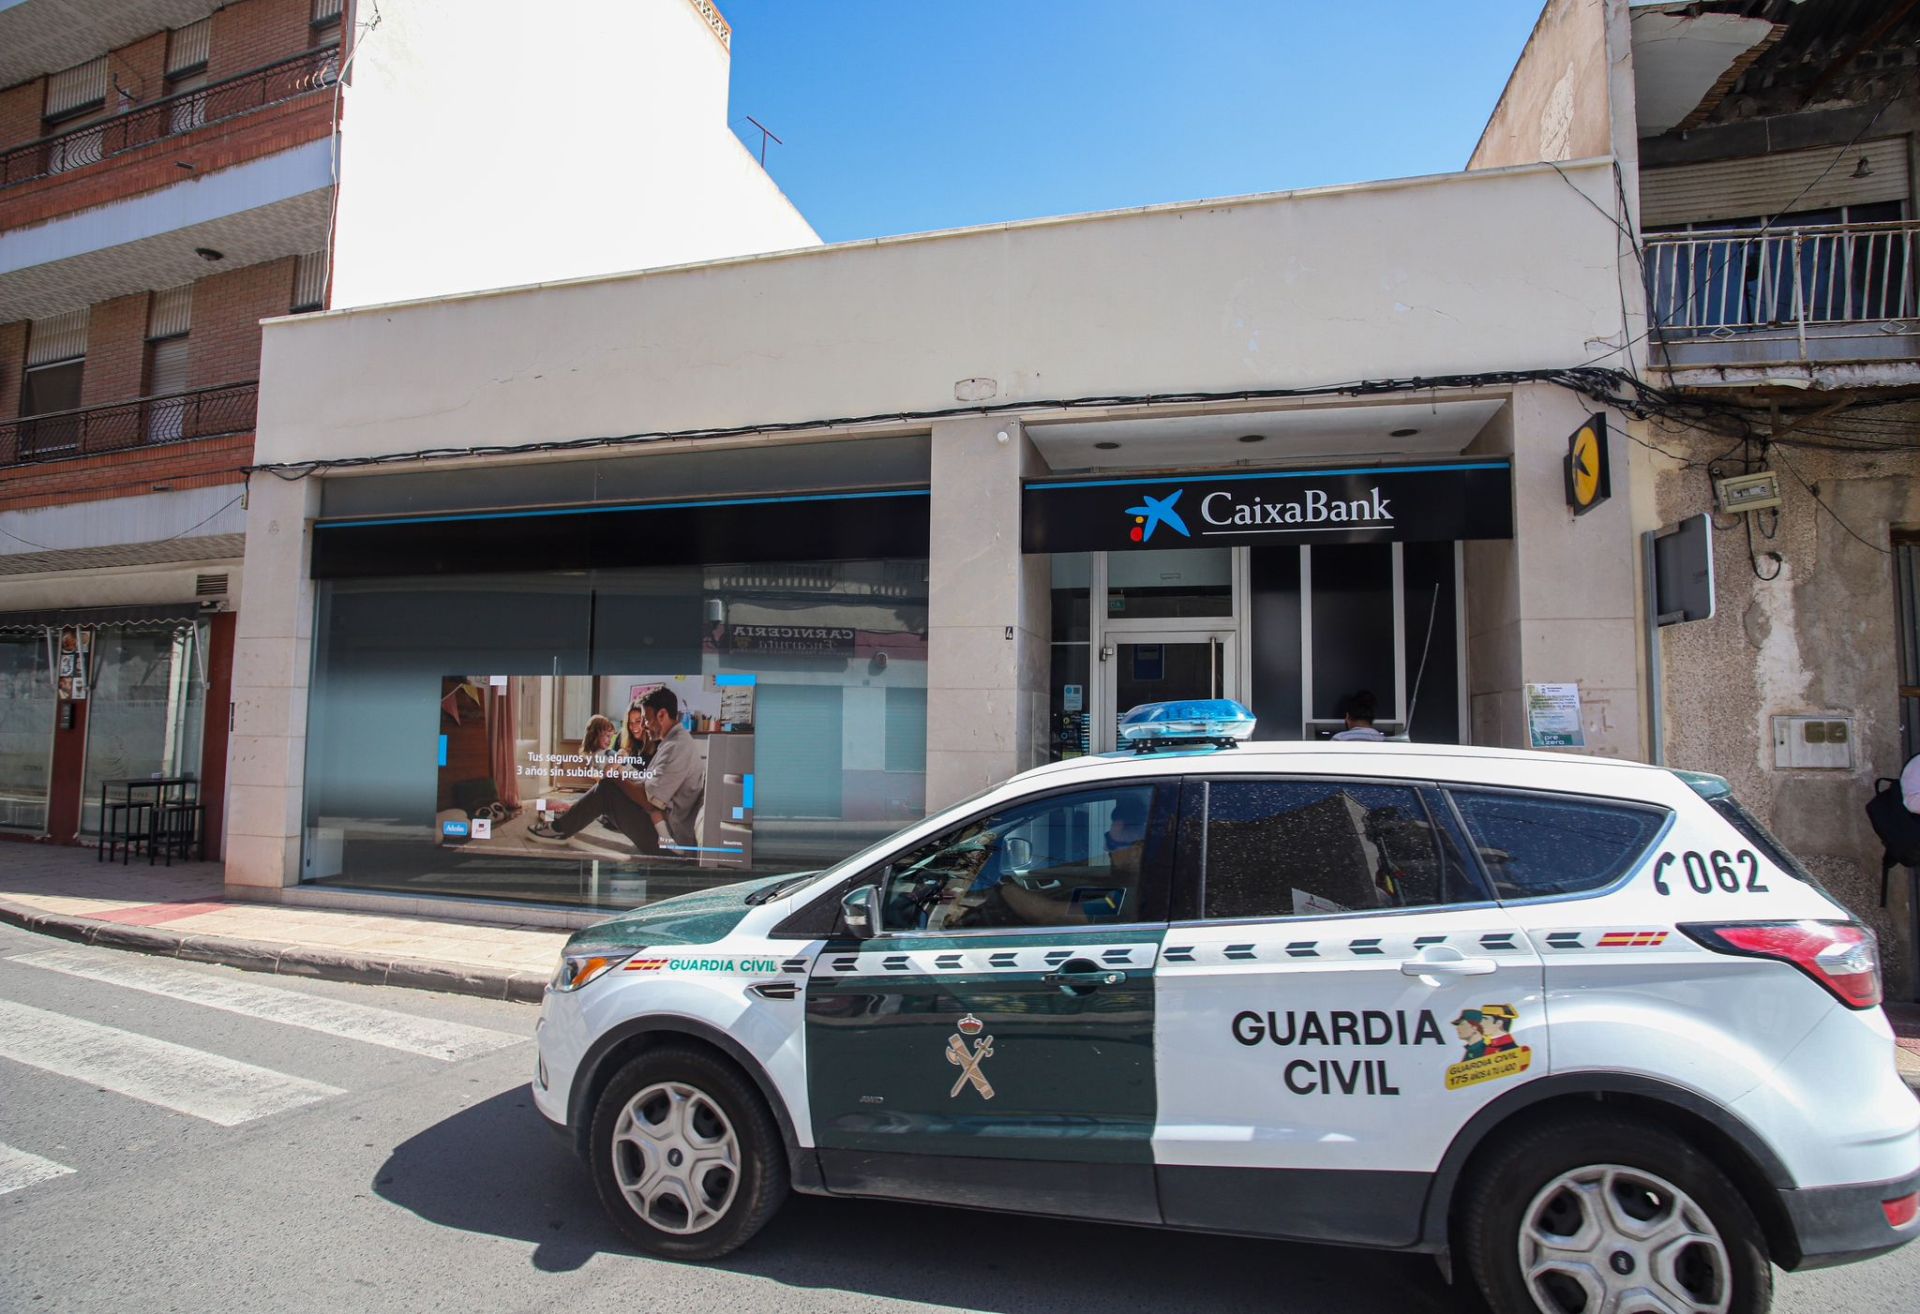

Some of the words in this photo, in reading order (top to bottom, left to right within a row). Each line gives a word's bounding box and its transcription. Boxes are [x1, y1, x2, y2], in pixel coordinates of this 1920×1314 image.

[1201, 487, 1394, 525] CaixaBank
[528, 752, 545, 762] Tus
[545, 753, 584, 765] seguros
[586, 755, 593, 765] y
[595, 754, 606, 764] tu
[608, 754, 646, 766] alarma,
[516, 765, 523, 776] 3
[525, 765, 548, 776] años
[550, 765, 564, 777] sin
[566, 766, 604, 778] subidas
[606, 767, 619, 779] de
[1682, 849, 1769, 894] 062
[669, 959, 735, 971] GUARDIA
[740, 960, 777, 972] CIVIL
[1232, 1010, 1446, 1046] GUARDIA
[1449, 1058, 1492, 1075] GUARDIA
[1283, 1059, 1400, 1095] CIVIL
[1451, 1073, 1469, 1086] 175
